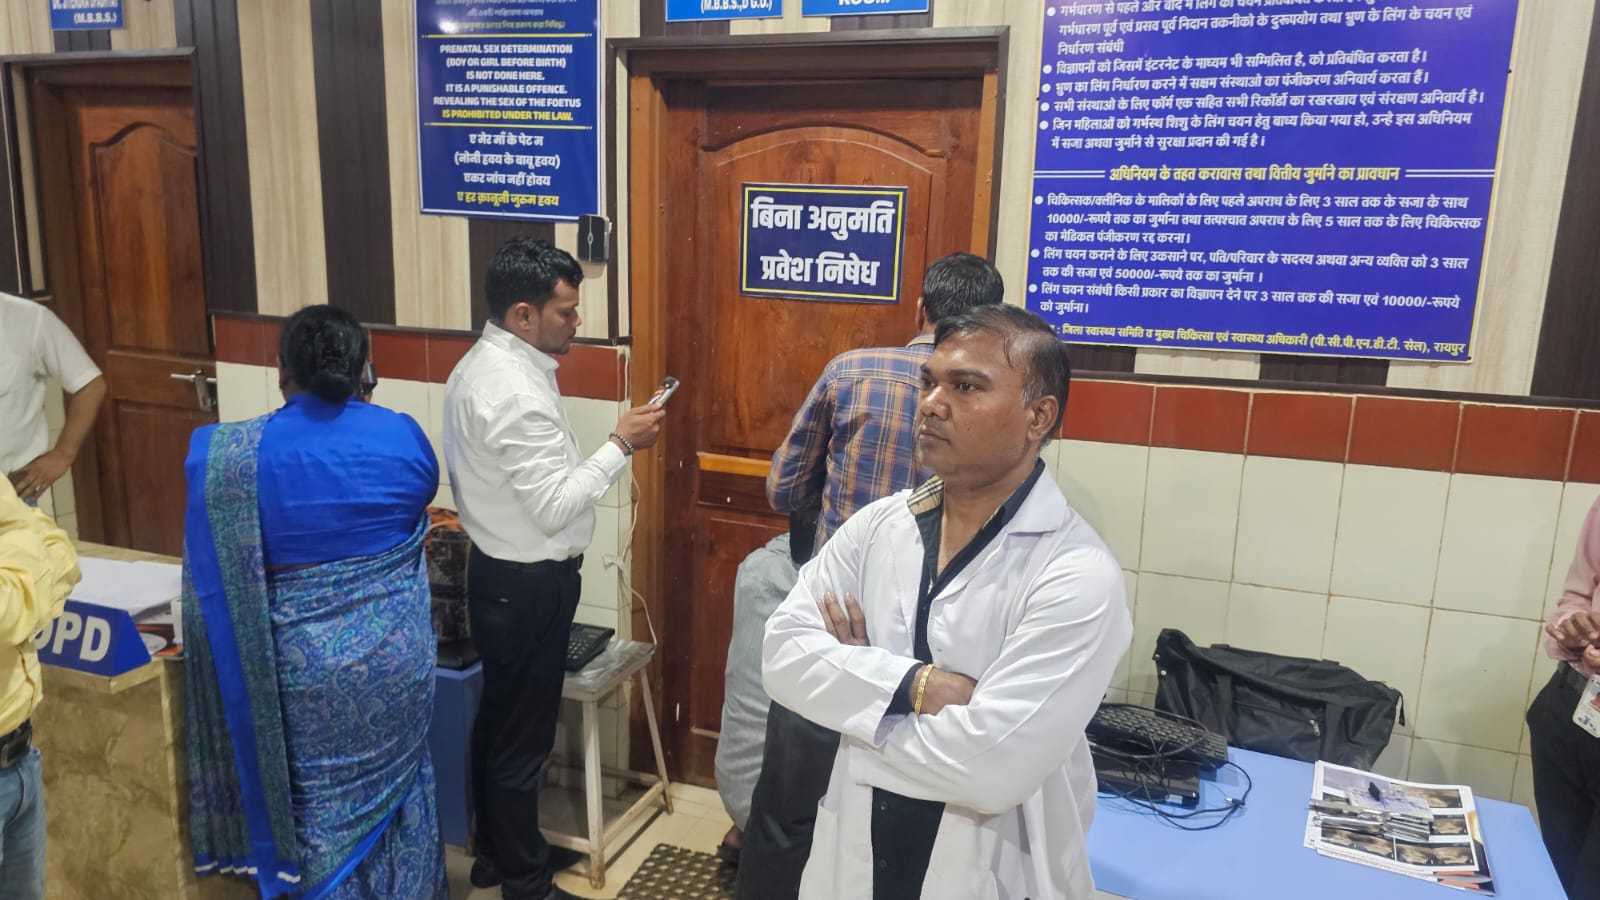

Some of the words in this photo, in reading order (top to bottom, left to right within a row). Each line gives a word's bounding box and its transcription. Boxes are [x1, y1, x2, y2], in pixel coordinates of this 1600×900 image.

[73, 12, 117, 24] (M.B.B.S.)
[440, 44, 483, 53] PRENATAL
[483, 44, 500, 53] SEX
[501, 44, 573, 54] DETERMINATION
[446, 57, 467, 68] (BOY
[467, 58, 480, 66] OR
[480, 58, 500, 66] GIRL
[501, 58, 535, 67] BEFORE
[535, 58, 566, 68] BIRTH)
[1097, 59, 1112, 72] को
[1113, 57, 1144, 72] जिसमें
[1144, 56, 1181, 72] इंटरनेट
[1182, 56, 1194, 69] के
[1194, 57, 1228, 69] माध्यम
[1230, 53, 1243, 67] भी
[1309, 51, 1325, 65] को
[1326, 49, 1376, 65] प्रतिबंधित
[1377, 51, 1410, 63] करता
[466, 71, 475, 79] IS
[475, 71, 493, 79] NOT
[494, 71, 518, 80] DONE
[519, 71, 545, 80] HERE.
[445, 83, 455, 92] IT
[454, 84, 463, 92] IS
[470, 84, 525, 93] PUNISHABLE
[526, 84, 567, 94] OFFENCE.
[433, 96, 479, 105] REVEALING
[480, 97, 498, 106] THE
[498, 97, 515, 106] SEX
[515, 98, 527, 106] OF
[528, 98, 546, 107] THE
[547, 98, 581, 108] FOETUS
[1054, 98, 1075, 111] सभी
[1118, 97, 1129, 110] के
[1130, 96, 1150, 111] लिए
[1152, 95, 1174, 109] फॉर्म
[1176, 98, 1194, 110] एक
[1195, 94, 1224, 109] सहित
[1225, 93, 1249, 107] सभी
[1289, 95, 1306, 106] का
[1307, 94, 1358, 106] रखरखाव
[1359, 91, 1376, 106] एवं
[1378, 91, 1419, 104] संरक्षण
[1420, 88, 1467, 104] अनिवार्य
[442, 109, 451, 118] IS
[451, 109, 502, 119] PROHIBITED
[501, 111, 532, 119] UNDER
[533, 111, 551, 120] THE
[551, 112, 573, 121] LAW.
[1053, 117, 1072, 130] जिन
[1116, 116, 1131, 129] को
[1132, 115, 1164, 129] गर्भस्थ
[1190, 114, 1203, 128] के
[1204, 114, 1226, 127] लिंग
[1227, 116, 1253, 127] चयन
[1255, 113, 1271, 130] हेतु
[1272, 115, 1299, 126] बाध्य
[1300, 112, 1328, 126] किया
[1329, 115, 1352, 126] गया
[1395, 114, 1416, 126] इस
[1417, 110, 1472, 125] अधिनियम
[506, 132, 518, 145] के
[517, 132, 533, 146] पेट
[1051, 136, 1060, 149] में
[1061, 138, 1083, 149] सजा
[1084, 138, 1113, 148] अथवा
[1144, 134, 1155, 147] से
[1156, 137, 1186, 151] सुरक्षा
[1187, 136, 1214, 147] प्रदान
[1216, 133, 1230, 147] की
[1232, 132, 1249, 148] गई
[481, 154, 503, 165] हवय
[503, 152, 515, 165] के
[515, 155, 535, 169] बाबू
[534, 154, 560, 169] हवय)
[506, 171, 526, 186] नहीं
[526, 172, 551, 186] होवय
[1109, 165, 1158, 181] अधिनियम
[1159, 164, 1172, 180] के
[1173, 168, 1197, 181] तहत
[1198, 168, 1243, 180] करावास
[1244, 168, 1267, 180] तथा
[1269, 164, 1302, 180] वित्तीय
[1338, 167, 1355, 180] का
[1355, 167, 1401, 180] प्रावधान
[537, 195, 560, 206] हवय
[1135, 193, 1147, 206] के
[1186, 193, 1198, 206] के
[1200, 193, 1220, 207] लिए
[1221, 193, 1245, 207] पहले
[1247, 196, 1283, 206] अपराध
[1285, 193, 1298, 206] के
[1299, 193, 1321, 208] लिए
[1323, 196, 1331, 207] 3
[1334, 196, 1360, 207] साल
[1361, 197, 1382, 207] तक
[1384, 194, 1396, 207] के
[1396, 197, 1425, 208] सजा
[1427, 194, 1441, 208] के
[1441, 197, 1469, 208] साथ
[751, 196, 803, 230] बिना
[808, 200, 895, 241] अनुमति
[1045, 231, 1059, 241] का
[1060, 229, 1095, 242] मेडिकल
[1097, 229, 1140, 242] पंजीकरण
[760, 249, 813, 282] प्रवेश
[815, 251, 881, 286] निषेध
[1042, 267, 1060, 276] तक
[1061, 264, 1074, 277] की
[1076, 268, 1098, 277] सजा
[1099, 266, 1113, 279] एवं
[1185, 270, 1204, 280] तक
[1205, 271, 1220, 281] का
[1222, 268, 1255, 285] जुर्माना
